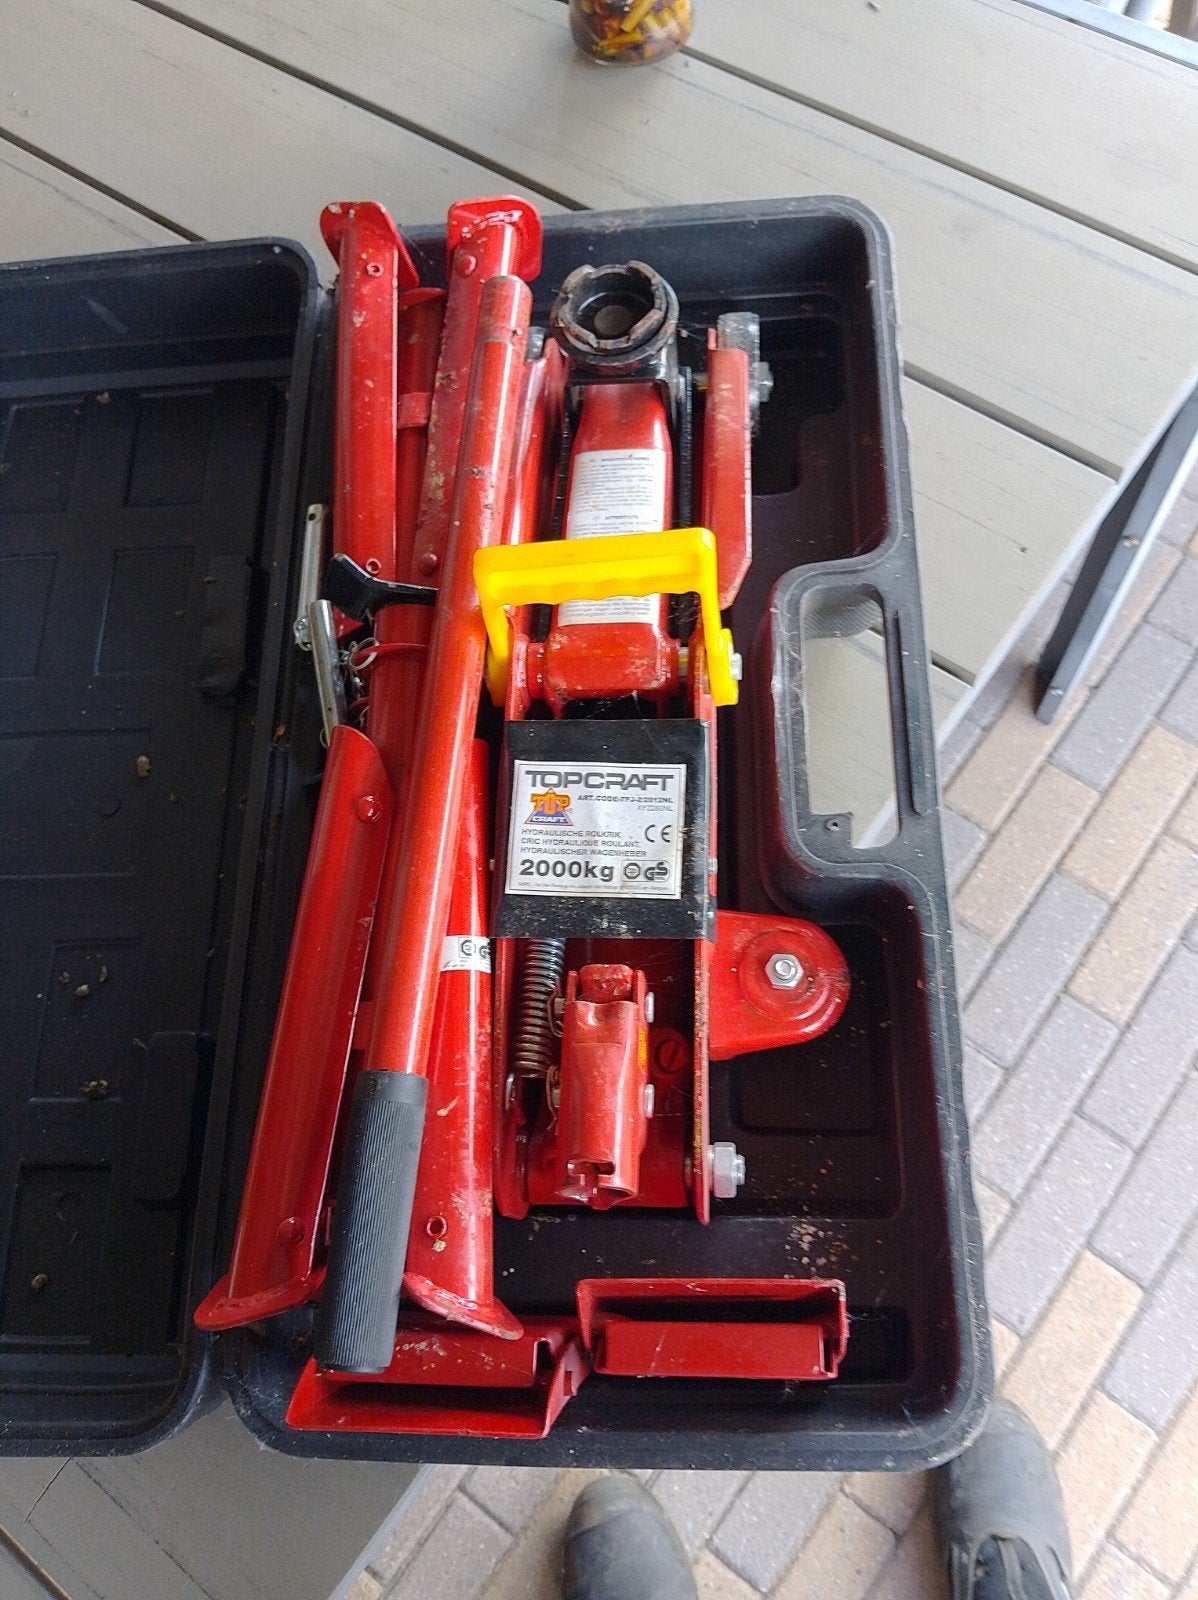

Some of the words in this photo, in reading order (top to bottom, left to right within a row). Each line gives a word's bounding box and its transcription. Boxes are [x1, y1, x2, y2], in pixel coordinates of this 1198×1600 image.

[525, 770, 674, 791] TOPCRAFT
[532, 815, 567, 823] CRAFT
[521, 828, 583, 838] HYDRAULISCHE
[645, 824, 672, 843] CE
[520, 837, 541, 846] CRIC
[542, 838, 599, 848] HYDRAULIQUE
[520, 846, 588, 856] HYDRAULISCHER
[590, 849, 647, 858] WAGENHEBER
[519, 859, 614, 882] 2000kg
